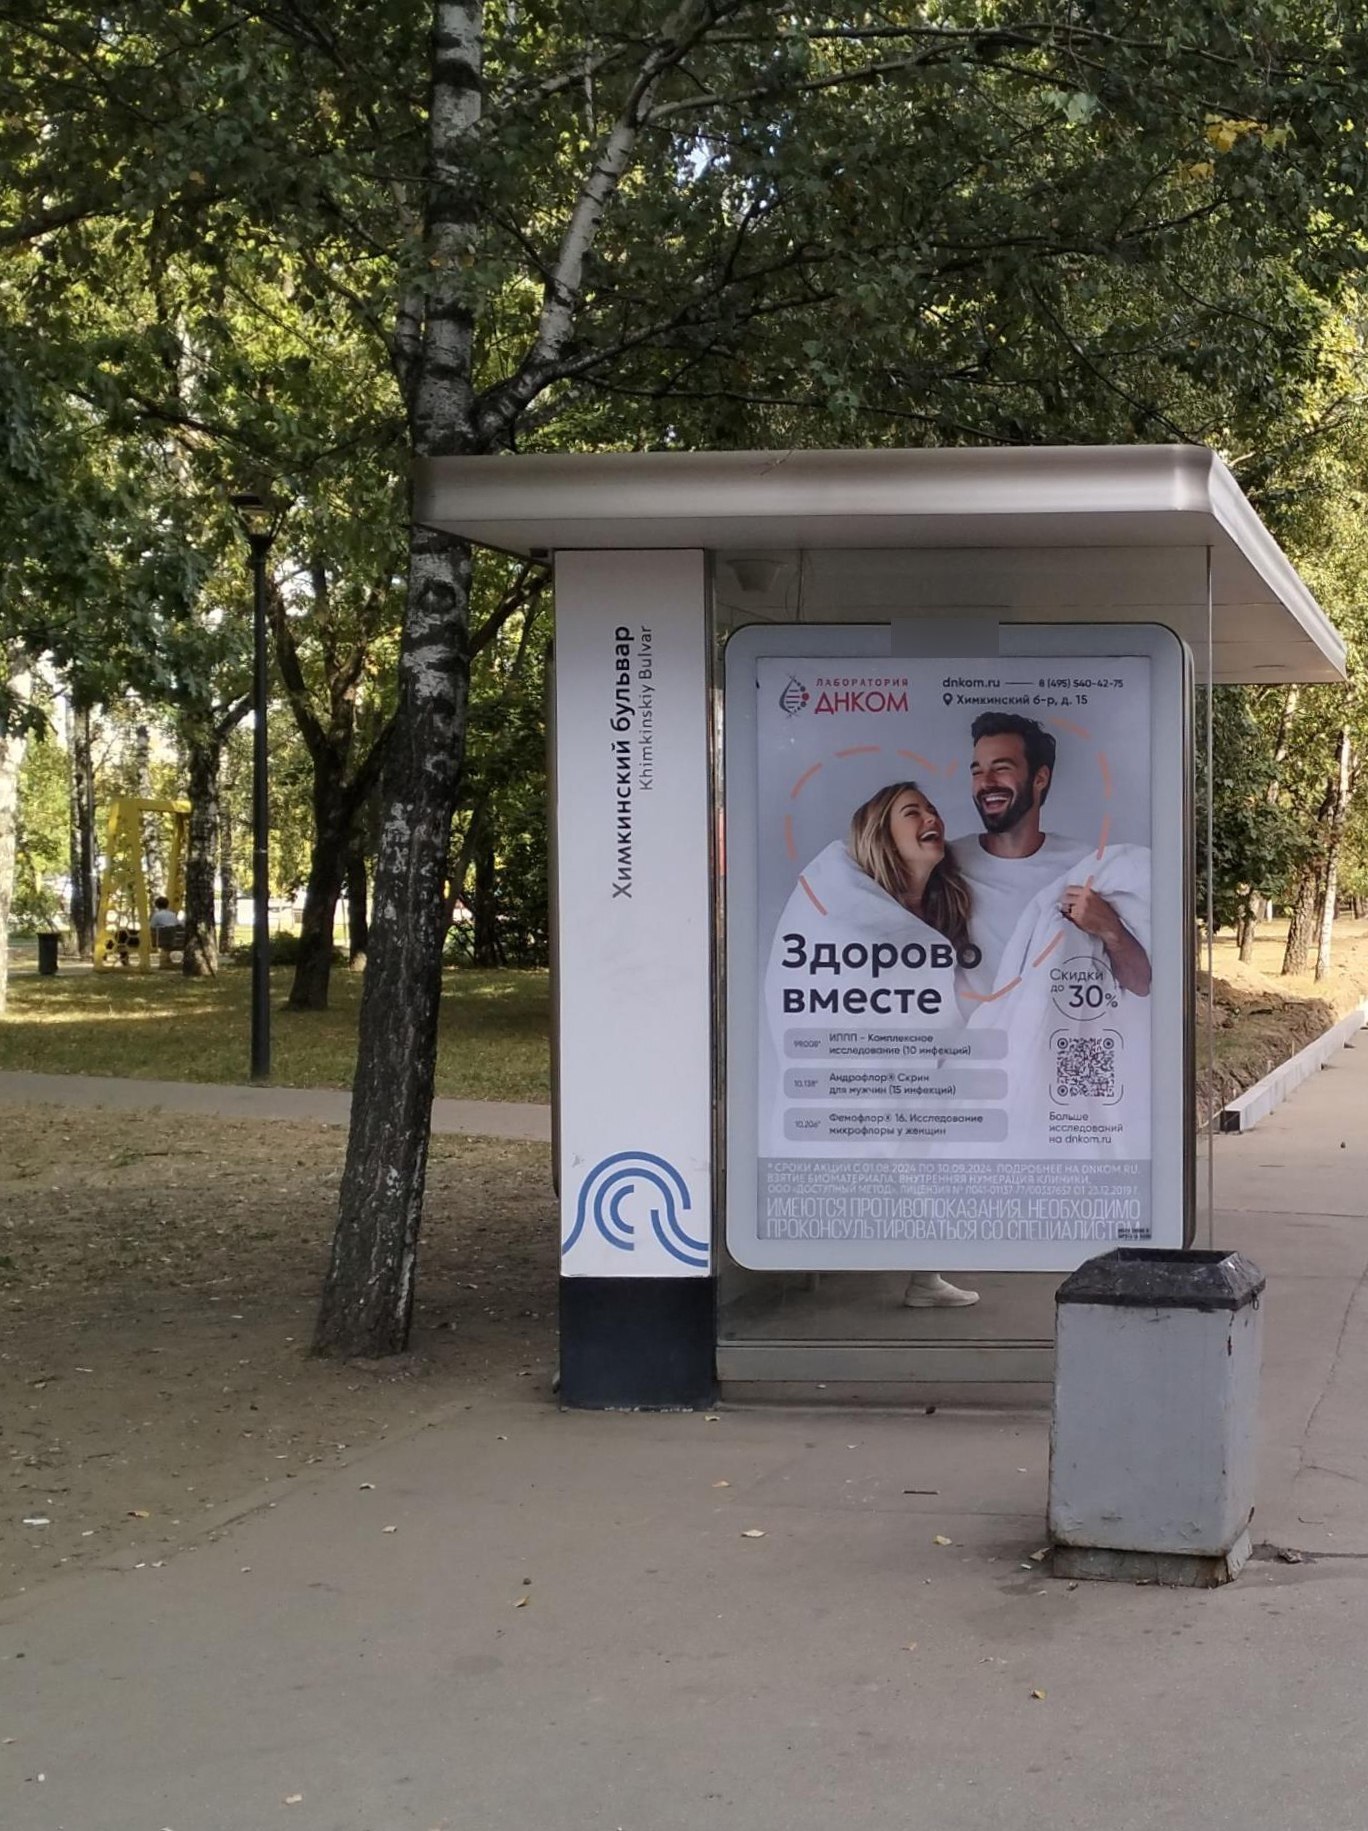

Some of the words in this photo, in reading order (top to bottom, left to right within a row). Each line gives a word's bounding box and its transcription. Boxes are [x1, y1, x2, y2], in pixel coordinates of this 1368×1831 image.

[638, 625, 653, 680] Bulvar
[610, 626, 635, 732] бульвар
[815, 678, 909, 687] ЛАБОРАТОРИЯ
[942, 677, 1000, 688] dnkom.ru
[1038, 679, 1045, 688] 8
[1047, 678, 1071, 689] (495)
[1073, 679, 1124, 688] 540-42-75
[814, 691, 909, 715] ДНКОМ
[956, 693, 1030, 705] Химкинский
[1060, 696, 1072, 707] д.
[1075, 695, 1088, 705] 15
[638, 684, 655, 791] Khimkinskiy
[611, 741, 633, 900] Химкинский
[781, 933, 982, 978] Здорово
[1049, 968, 1104, 982] Скидки
[783, 988, 942, 1015] вместе
[1050, 984, 1064, 993] до
[1068, 985, 1118, 1008] 30%
[829, 1033, 858, 1043] ИППП
[867, 1033, 934, 1043] Комплексное
[829, 1046, 900, 1055] исследование
[919, 1045, 971, 1056] инфекций)
[897, 1073, 930, 1083] Скрин
[828, 1086, 847, 1095] для
[849, 1086, 887, 1096] мужчин
[904, 1084, 956, 1096] инфекций)
[910, 1114, 984, 1124] Исследование
[1048, 1110, 1089, 1121] Больше
[829, 1127, 895, 1137] микрофлоры
[897, 1128, 903, 1137] у
[905, 1127, 946, 1137] женщин
[1048, 1124, 1124, 1133] исследований
[1048, 1136, 1062, 1144] на
[1065, 1134, 1112, 1144] dnkom.ru
[996, 1163, 1062, 1174] ПОДРОБНЕЕ
[767, 1197, 847, 1218] ИМЕЮТСЯ
[1028, 1198, 1141, 1220] НЕОБХОДИМО
[767, 1218, 977, 1240] ПРОКОНСУЛЬТИРОВАТЬСЯ
[981, 1219, 1003, 1240] СО
